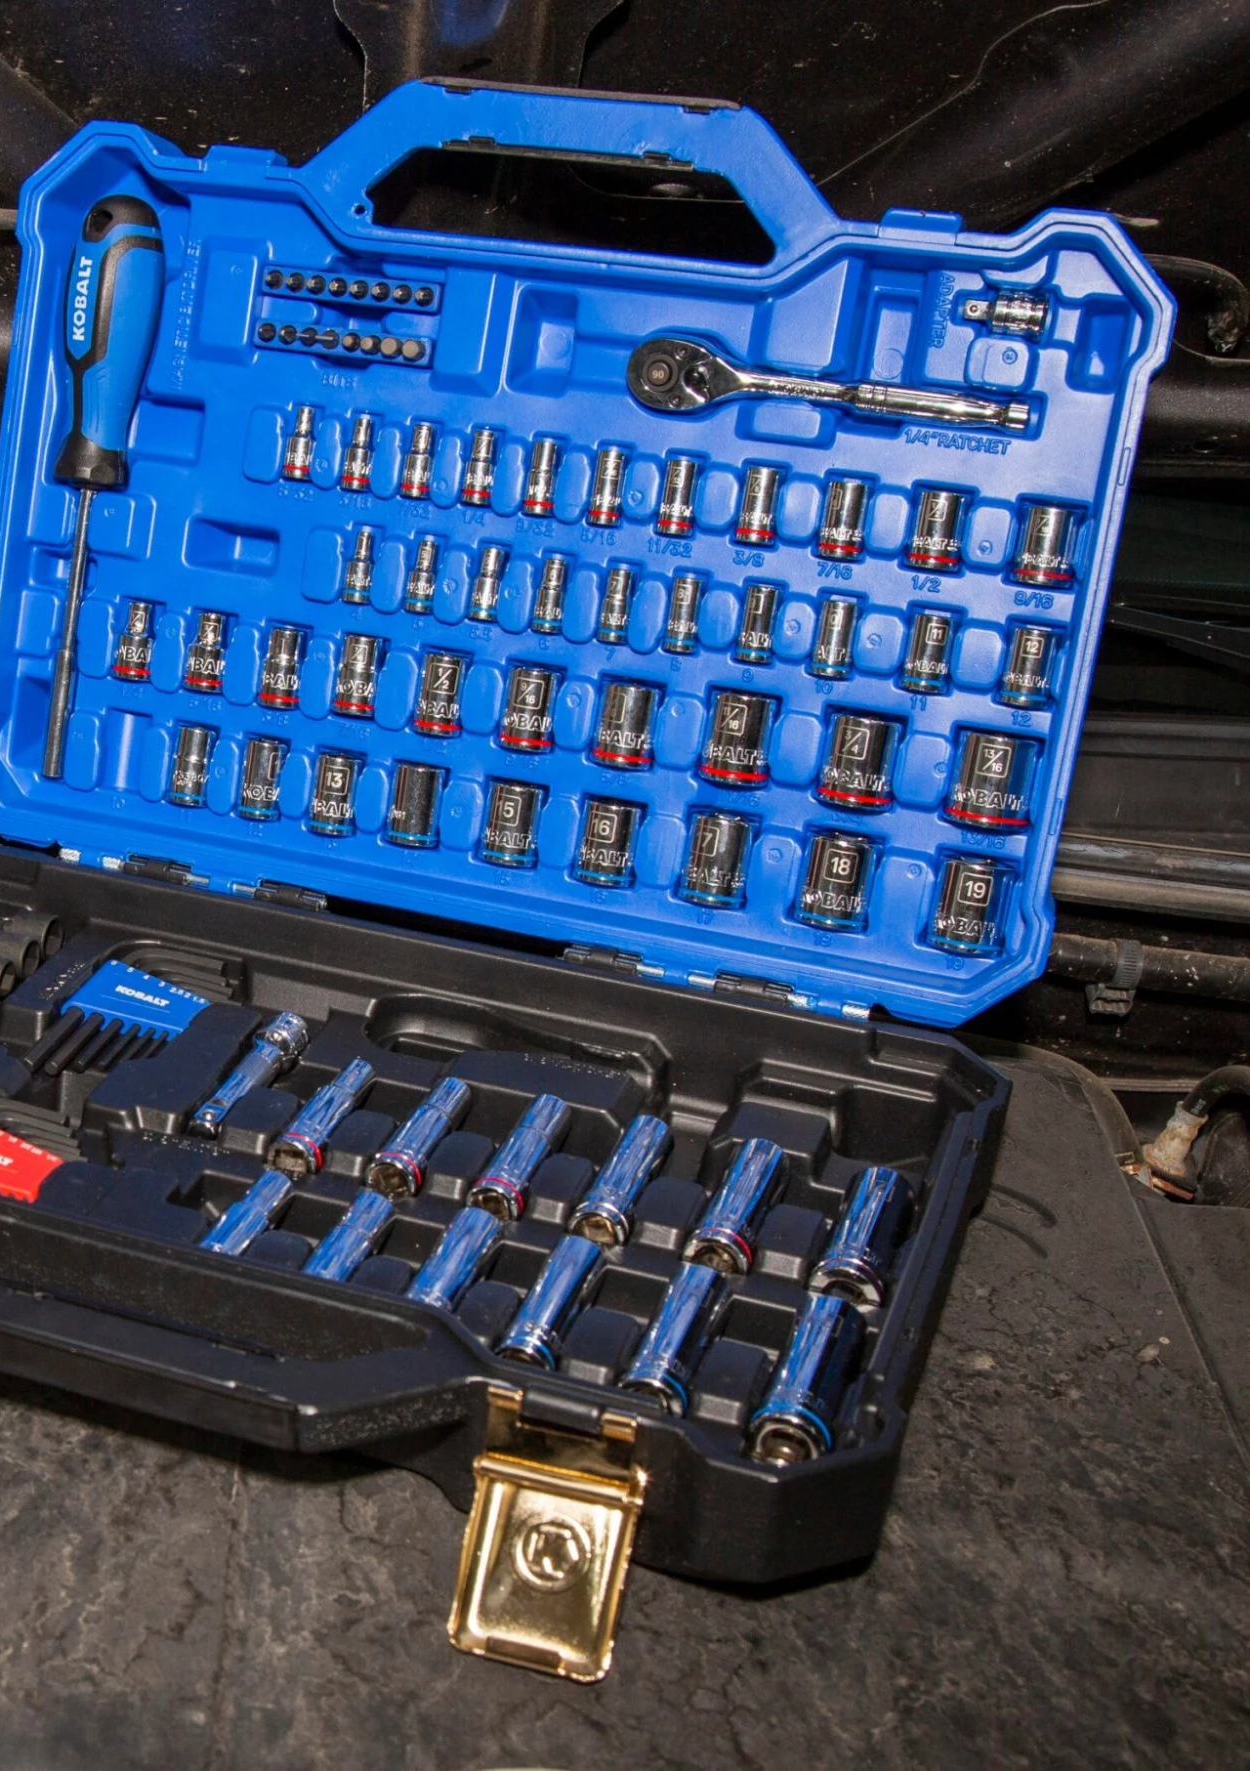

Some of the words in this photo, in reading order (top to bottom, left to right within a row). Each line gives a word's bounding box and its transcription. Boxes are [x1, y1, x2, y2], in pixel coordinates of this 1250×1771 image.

[72, 256, 93, 341] KOBALT
[930, 270, 955, 349] ADAPTER
[652, 369, 665, 379] 90
[461, 508, 485, 527] 1/4
[647, 538, 693, 559] 11/32
[733, 549, 766, 568] 3/8
[816, 561, 854, 580] 7/16
[910, 575, 942, 593] 1/2
[1014, 590, 1055, 610] 9/16
[932, 628, 943, 640] 11
[538, 638, 549, 651] 6
[605, 647, 617, 661] 7
[1025, 642, 1039, 654] 12
[434, 668, 452, 690] 1/2
[741, 667, 755, 683] 9
[517, 683, 536, 704] 9/16
[814, 680, 835, 695] 10
[909, 694, 927, 711] 11
[721, 707, 740, 730] 11/16
[1011, 711, 1032, 728] 12
[842, 729, 862, 754] 3/4
[982, 748, 1005, 773] 13/16
[325, 771, 344, 789] 13
[593, 818, 611, 836] 16
[831, 857, 851, 876] 18
[965, 880, 987, 899] 19
[115, 984, 170, 1008] KOBALT
[170, 986, 184, 996] 2.5
